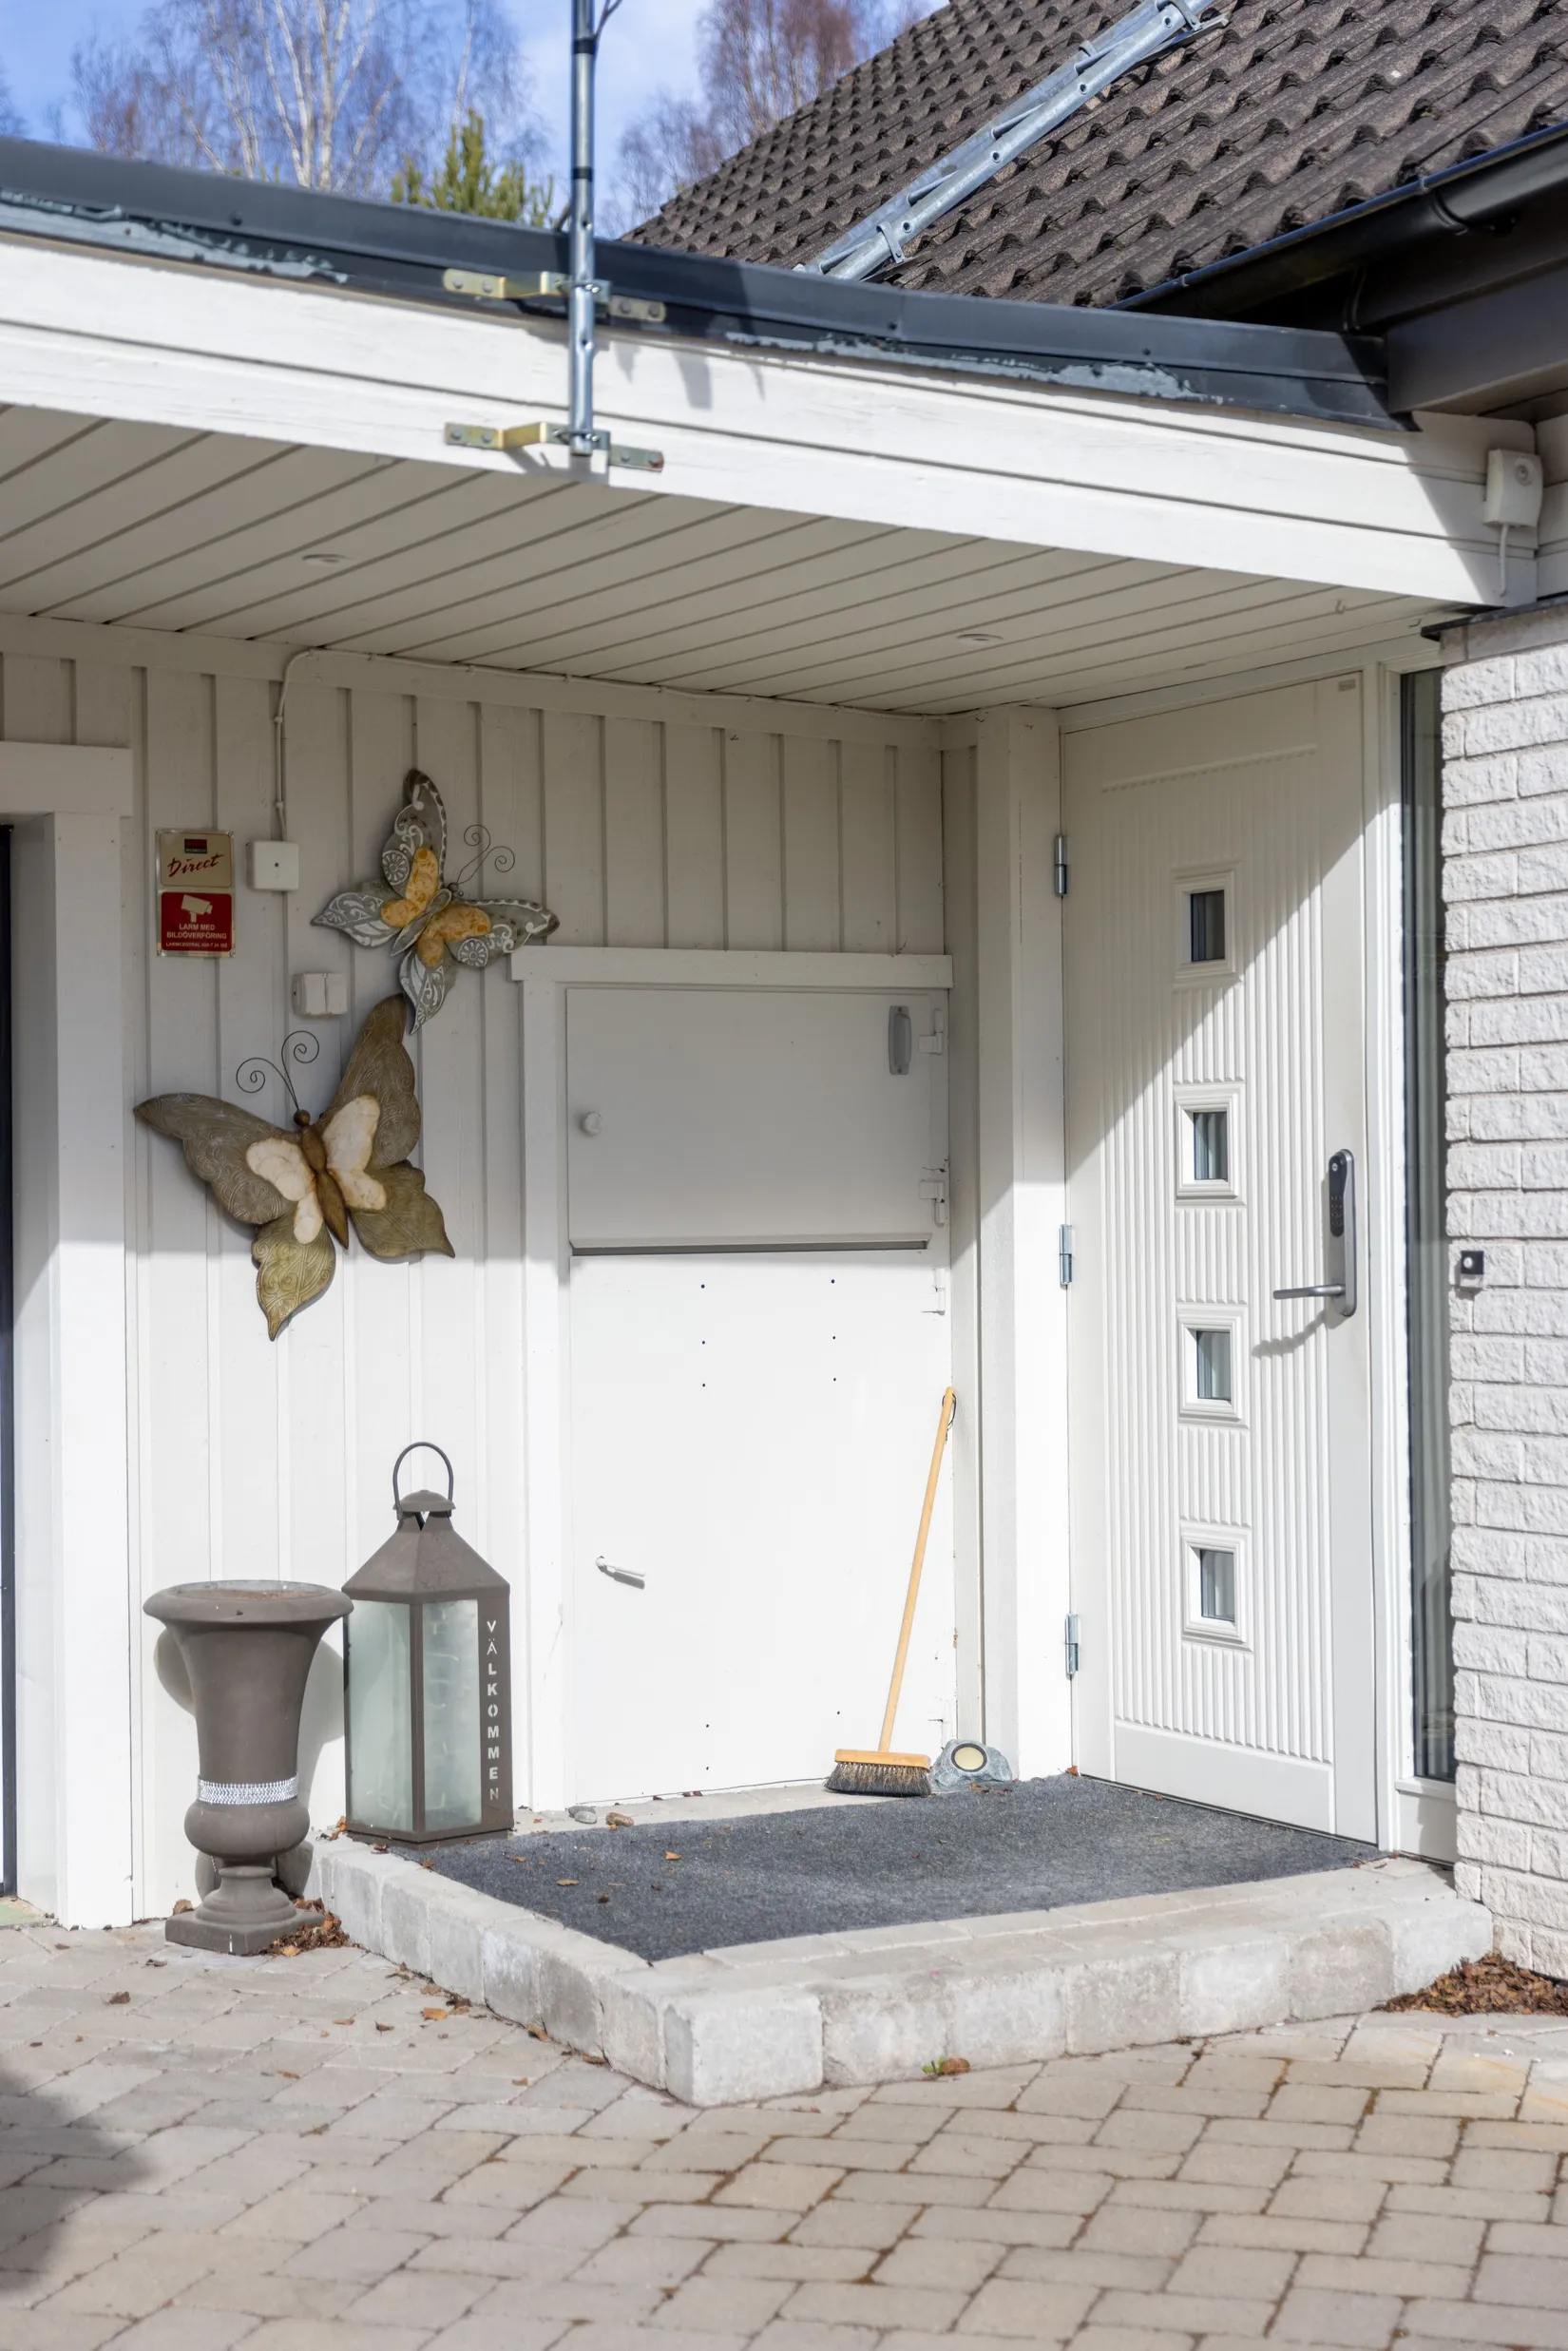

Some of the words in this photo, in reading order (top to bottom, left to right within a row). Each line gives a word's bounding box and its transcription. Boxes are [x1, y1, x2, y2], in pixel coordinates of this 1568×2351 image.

[167, 852, 224, 877] Direct
[166, 930, 227, 940] BILDÖVERFÖRING
[486, 1620, 500, 1801] VÄLKOMMEN
